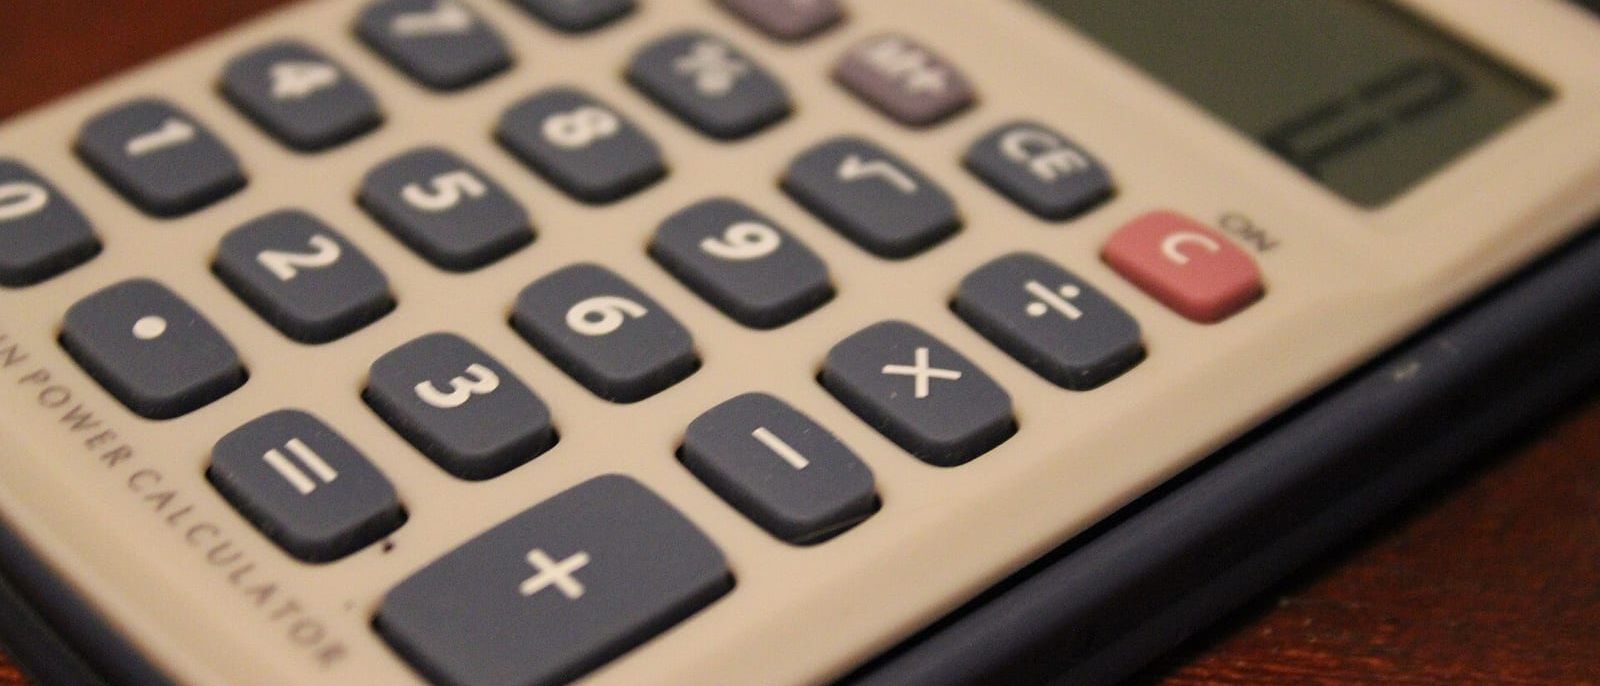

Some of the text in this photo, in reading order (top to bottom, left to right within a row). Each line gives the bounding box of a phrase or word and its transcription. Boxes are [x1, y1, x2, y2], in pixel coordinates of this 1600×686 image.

[391, 7, 468, 35] 7
[272, 61, 339, 97] 4
[126, 118, 195, 155] 1
[541, 106, 620, 148] 8
[1001, 127, 1089, 182] CE
[0, 182, 47, 219] 0
[402, 170, 488, 211] 5
[700, 221, 780, 260] 9
[1161, 231, 1219, 264] C
[1219, 211, 1279, 251] ON
[257, 234, 341, 281] 2
[566, 295, 648, 336] 6
[414, 363, 501, 408] 3
[18, 369, 133, 469] POWER
[128, 469, 347, 665] CALCULATOR
